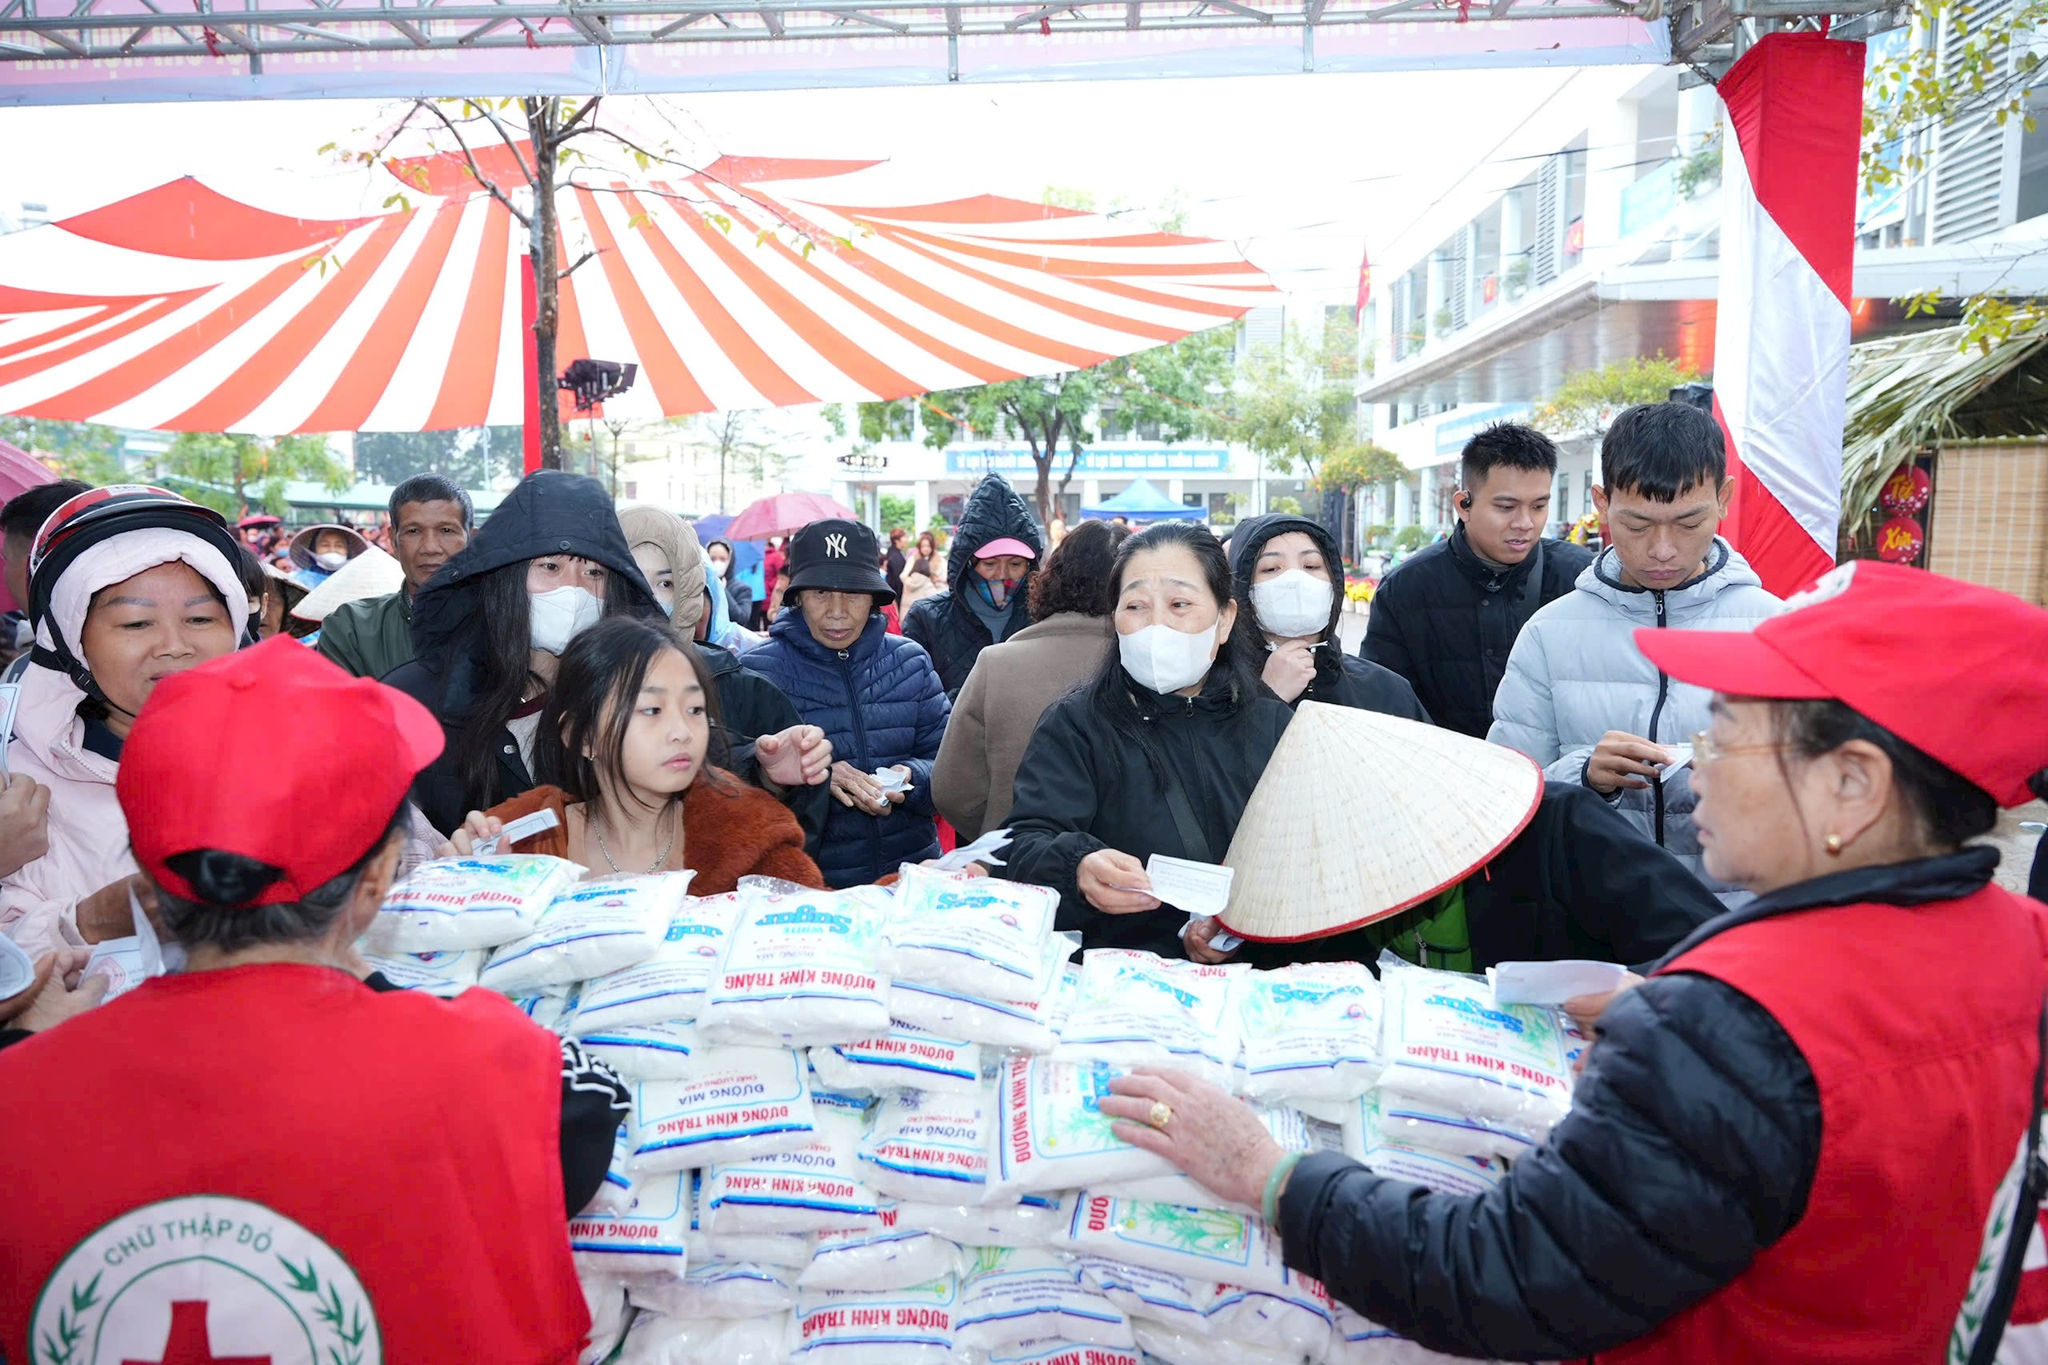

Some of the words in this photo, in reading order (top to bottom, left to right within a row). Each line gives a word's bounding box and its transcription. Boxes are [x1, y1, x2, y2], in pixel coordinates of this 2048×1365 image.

[824, 533, 848, 559] NY
[427, 892, 465, 907] KÍNH
[755, 905, 852, 934] Sugar
[724, 973, 774, 993] TRẮNG
[781, 969, 816, 985] KÍNH
[821, 971, 875, 990] ĐƯỜNG
[875, 1039, 907, 1055] KÍNH
[910, 1043, 955, 1062] ĐƯỜNG
[1406, 1046, 1460, 1063] TRẮNG
[1465, 1052, 1505, 1072] KÍNH
[677, 1092, 706, 1106] MÍA
[710, 1084, 764, 1099] ĐƯỜNG
[1010, 1078, 1027, 1111] KÍNH
[706, 1112, 739, 1127] KÍNH
[742, 1106, 789, 1122] ĐƯỜNG
[657, 1115, 702, 1134] TRẮNG
[926, 1125, 977, 1140] ĐƯỜNG
[1011, 1111, 1031, 1163] ĐƯỜNG
[781, 1152, 836, 1168] ĐƯỜNG
[913, 1148, 944, 1163] KÍNH
[772, 1178, 805, 1196] KÍNH
[808, 1181, 854, 1198] ĐƯỜNG
[103, 1222, 156, 1267] CHỮ
[162, 1211, 235, 1243] THẬP
[237, 1223, 274, 1254] ĐỎ
[569, 1223, 605, 1239] KÍNH
[609, 1223, 658, 1239] ĐƯỜNG
[802, 1310, 846, 1339] TRẮNG
[852, 1309, 891, 1329] KÍNH
[896, 1309, 949, 1333] ĐƯỜNG
